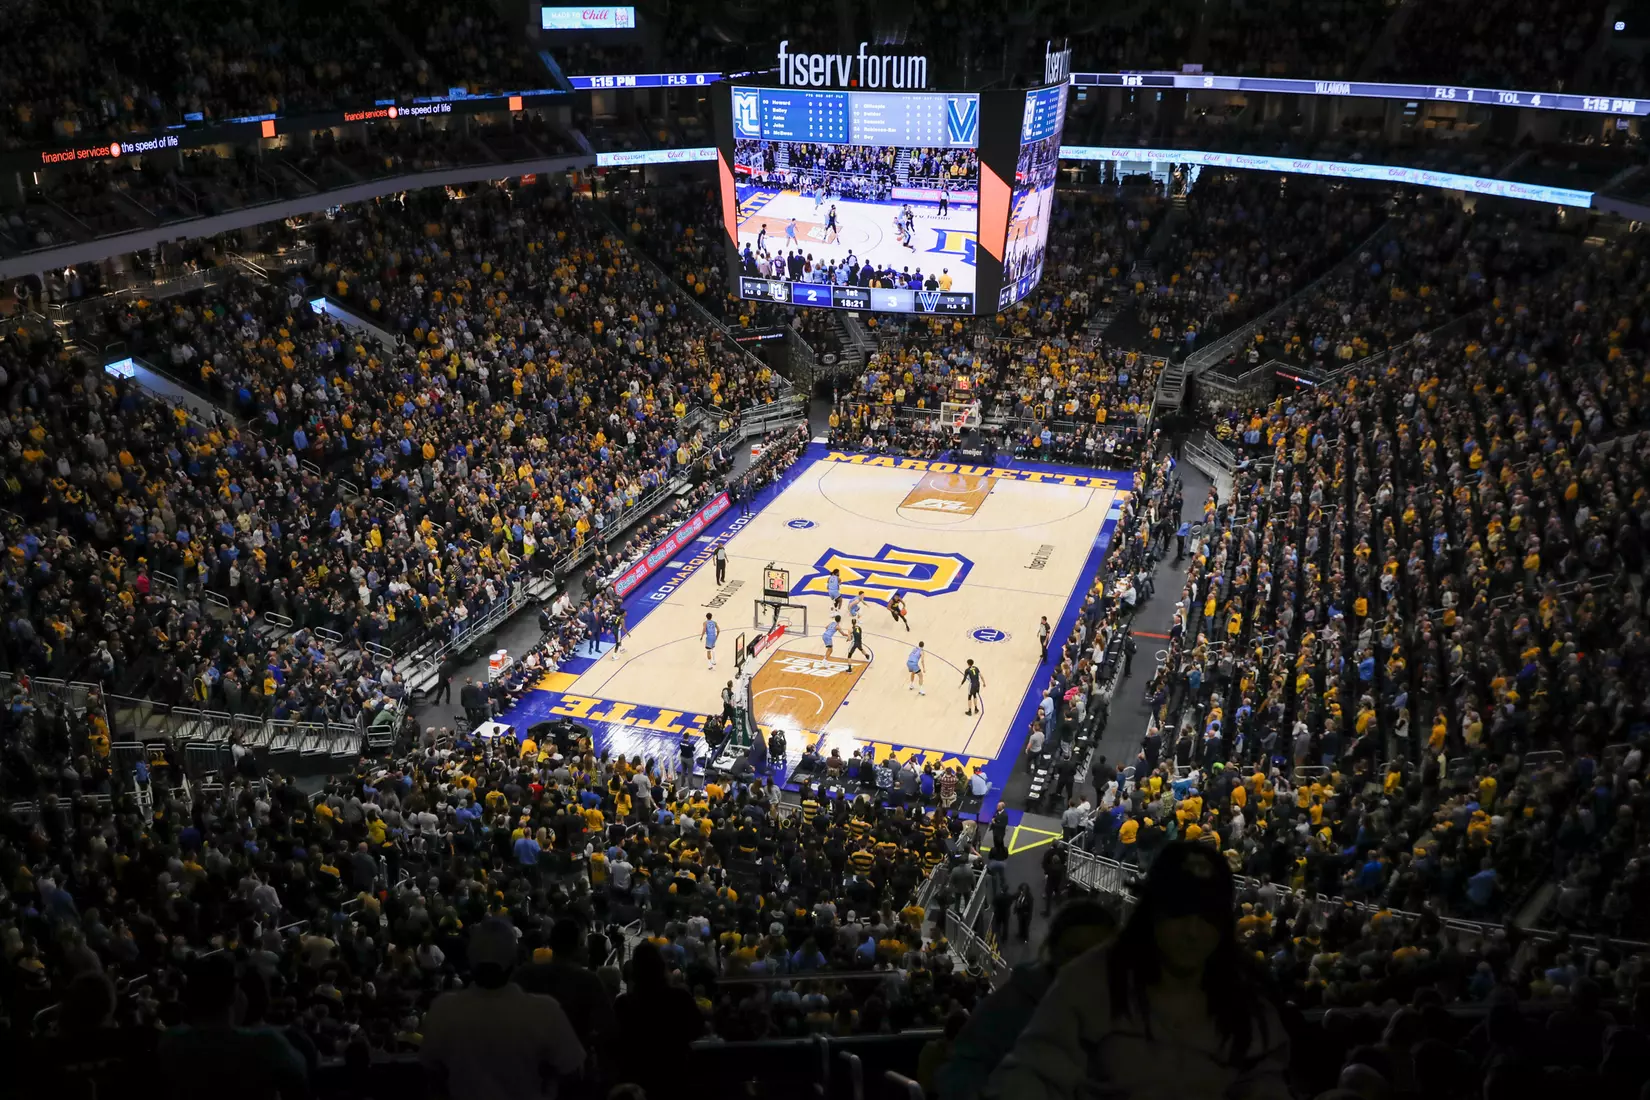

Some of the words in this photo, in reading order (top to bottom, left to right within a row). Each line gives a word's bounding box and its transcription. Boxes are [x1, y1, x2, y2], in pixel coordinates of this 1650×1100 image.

[582, 10, 608, 20] Chill
[591, 77, 612, 86] 1:15
[617, 76, 636, 86] PM
[668, 76, 687, 84] FLS
[696, 75, 704, 84] 0
[1122, 76, 1143, 86] 1st
[1204, 78, 1214, 88] 3
[1315, 82, 1350, 94] VILLANOVA
[1435, 88, 1456, 98] FLS
[1467, 90, 1474, 100] 1
[1498, 92, 1520, 104] TOL
[1530, 95, 1540, 106] 4
[1583, 98, 1608, 110] 1:15
[1612, 100, 1636, 112] PM
[344, 110, 364, 122] financial
[365, 108, 388, 120] services
[398, 106, 410, 116] the
[411, 104, 432, 116] speed
[433, 104, 441, 114] of
[441, 104, 452, 113] life
[42, 149, 76, 164] financial
[78, 146, 110, 159] services
[121, 142, 134, 153] the
[135, 138, 158, 152] speed
[158, 136, 166, 148] of
[167, 136, 179, 146] life
[668, 150, 684, 159] Chill
[1112, 149, 1130, 157] Chill
[807, 290, 817, 301] 2
[846, 289, 858, 297] 1st
[841, 298, 864, 308] 18:21
[888, 296, 898, 308] 3
[962, 448, 982, 457] meijer
[822, 451, 1119, 490] MARQUETTE
[651, 512, 756, 600] GOMARQUETTE.COM
